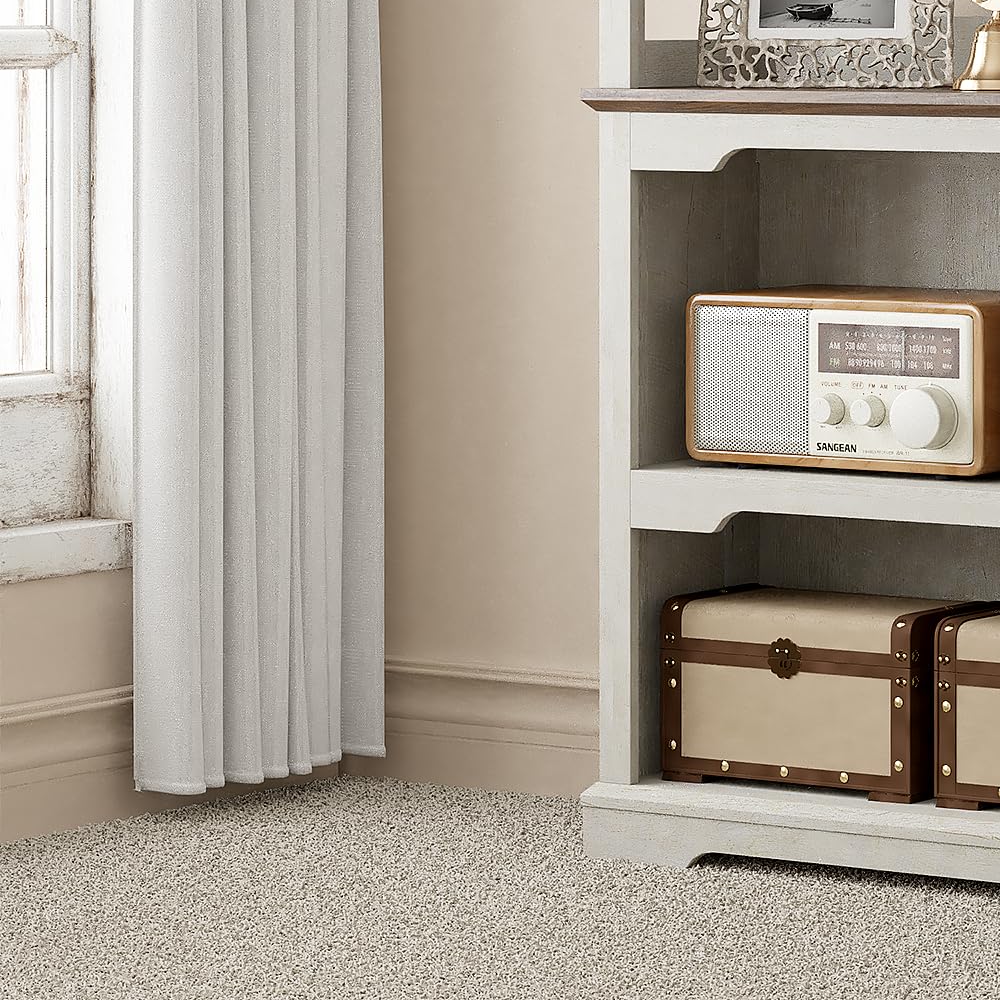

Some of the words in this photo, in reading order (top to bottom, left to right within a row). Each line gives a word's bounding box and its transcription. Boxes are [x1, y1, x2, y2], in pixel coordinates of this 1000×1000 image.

[828, 341, 841, 350] AM
[828, 358, 841, 368] FM
[816, 442, 857, 453] SANGEAN
